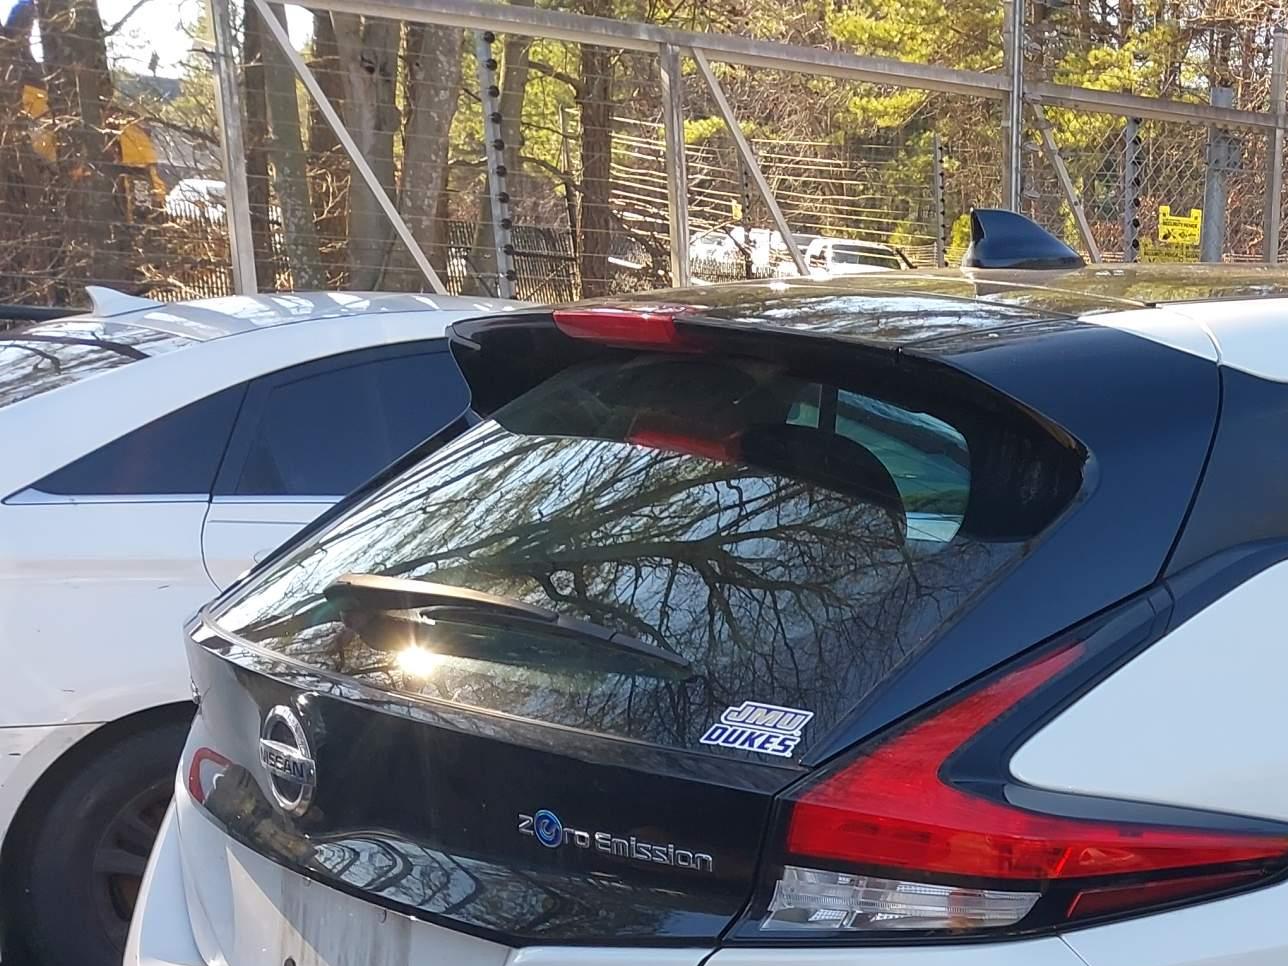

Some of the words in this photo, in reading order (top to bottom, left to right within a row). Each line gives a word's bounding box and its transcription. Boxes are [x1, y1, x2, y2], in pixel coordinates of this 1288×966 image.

[724, 704, 809, 732] JMU
[701, 724, 800, 755] DUKES
[594, 831, 713, 873] Emission
